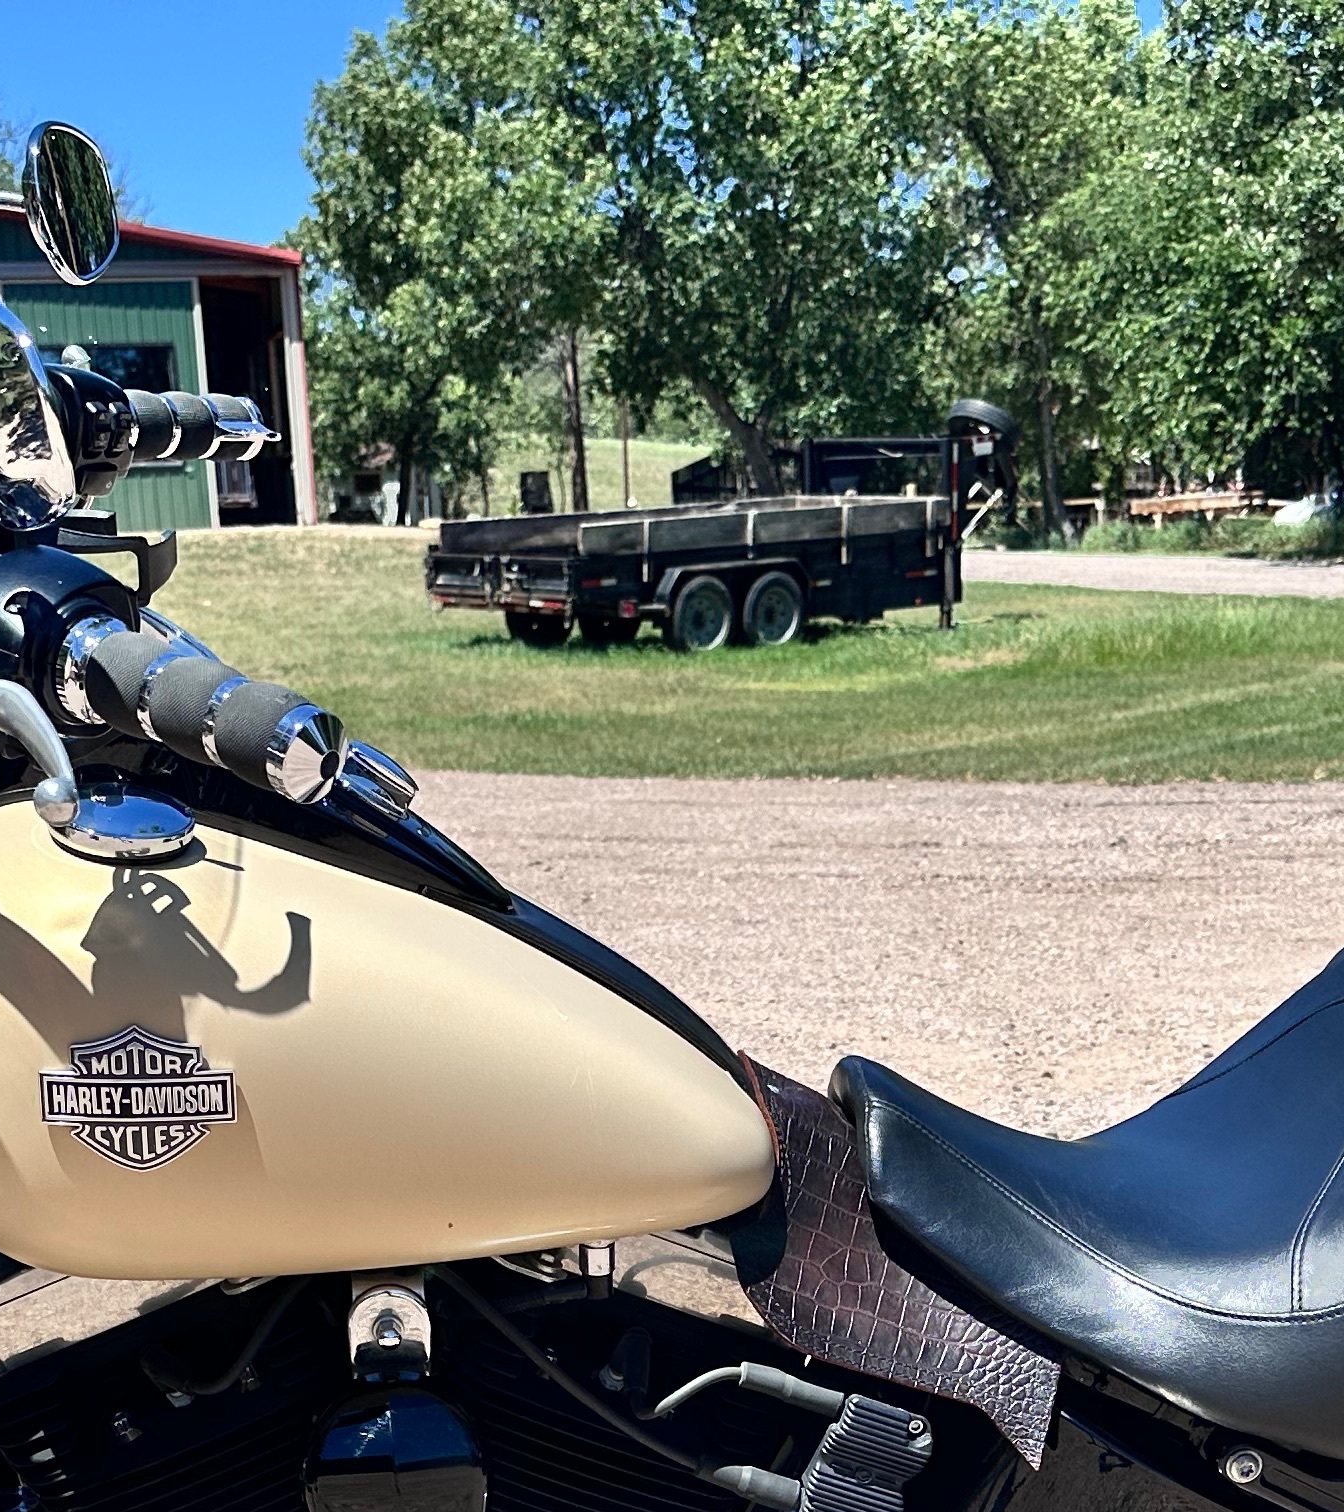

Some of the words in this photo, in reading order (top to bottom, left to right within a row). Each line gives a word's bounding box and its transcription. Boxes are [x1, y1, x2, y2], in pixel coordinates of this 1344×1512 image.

[91, 1042, 182, 1075] MOTOR
[53, 1084, 224, 1115] HARLEY-DAVIDSON
[94, 1124, 186, 1161] CYCLES
